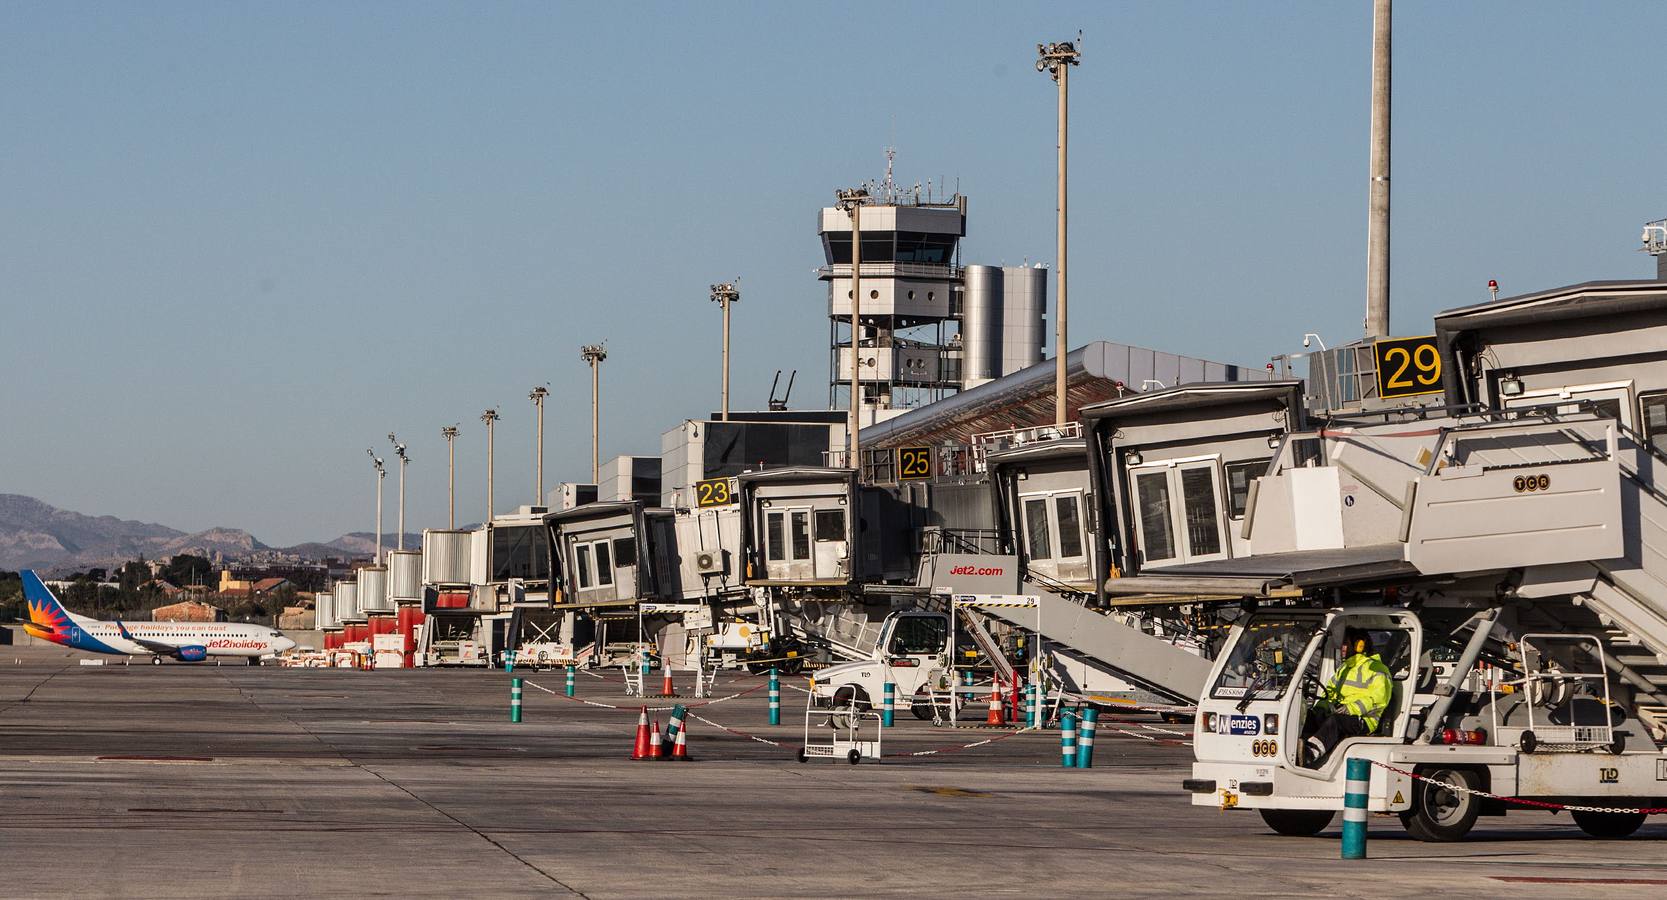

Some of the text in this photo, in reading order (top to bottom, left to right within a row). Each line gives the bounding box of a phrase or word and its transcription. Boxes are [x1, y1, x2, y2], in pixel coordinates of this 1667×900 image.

[1385, 344, 1441, 389] 29
[903, 451, 929, 474] 25
[1515, 477, 1548, 490] TCR
[700, 482, 728, 504] 23
[950, 565, 1003, 576] jet2.com
[1026, 597, 1035, 605] 29
[105, 624, 138, 632] Pacage
[141, 624, 173, 632] holidays
[205, 639, 268, 650] jet2holidays
[1219, 715, 1257, 733] Menzies
[1600, 767, 1619, 780] TLD
